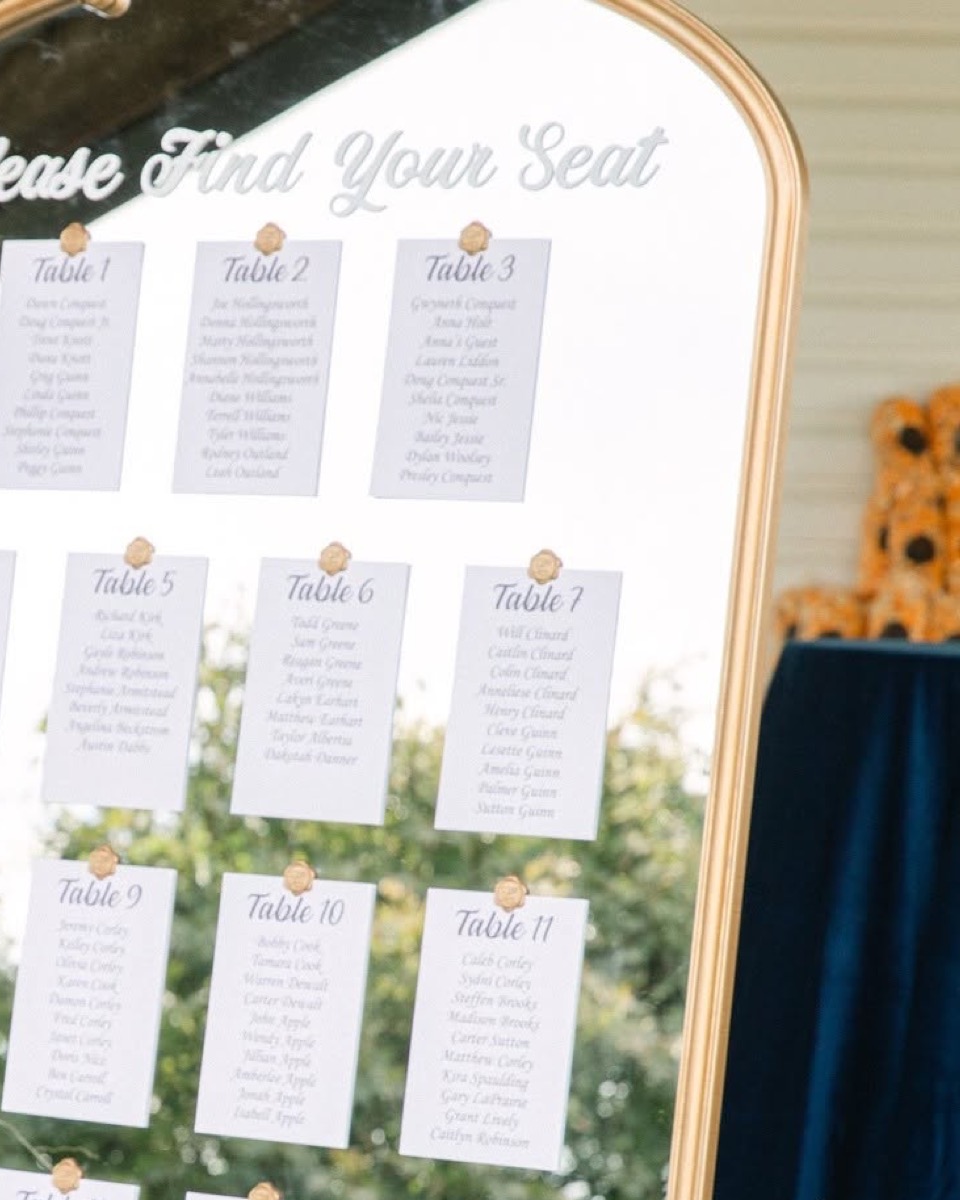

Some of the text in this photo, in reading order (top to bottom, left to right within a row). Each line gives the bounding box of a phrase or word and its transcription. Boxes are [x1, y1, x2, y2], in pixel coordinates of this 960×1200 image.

[140, 126, 312, 198] Find
[328, 128, 495, 219] Your
[517, 121, 669, 193] Seat
[33, 255, 112, 283] Table 1
[223, 255, 311, 283] Table 2
[425, 255, 516, 282] Table 3
[465, 297, 517, 313] Conquest
[466, 336, 498, 350] Guest
[416, 355, 455, 367] Lauren
[404, 373, 434, 388] Doug
[437, 374, 488, 390] Conquest
[245, 389, 292, 403] Williams
[446, 393, 497, 410] Conquest
[244, 409, 290, 422] Williams
[240, 427, 287, 441] Williams
[405, 448, 439, 465] Dylan
[442, 470, 493, 486] Conquest
[93, 567, 178, 597] Table 5
[286, 573, 376, 604] Table 6
[493, 582, 585, 613] Table 7
[291, 616, 359, 632] Todd Greene
[320, 638, 356, 652] Greene
[326, 657, 362, 671] Greene
[317, 676, 352, 690] Greene
[266, 710, 313, 724] Matthew
[483, 703, 520, 720] Henry
[58, 877, 143, 909] Table 9
[247, 892, 346, 926] Table 10
[455, 909, 555, 943] Table 11
[93, 941, 125, 958] Corley
[90, 958, 124, 975] Corley
[462, 952, 532, 973] Caleb Corley
[496, 974, 532, 992] Corley
[498, 995, 538, 1012] Brooks
[500, 1014, 540, 1032] Brooks
[451, 1031, 489, 1044] Carter
[442, 1049, 534, 1073] Matthew Corley
[441, 1089, 468, 1106] Gary
[445, 1107, 478, 1125] Grant
[477, 1130, 530, 1149] Robinson
